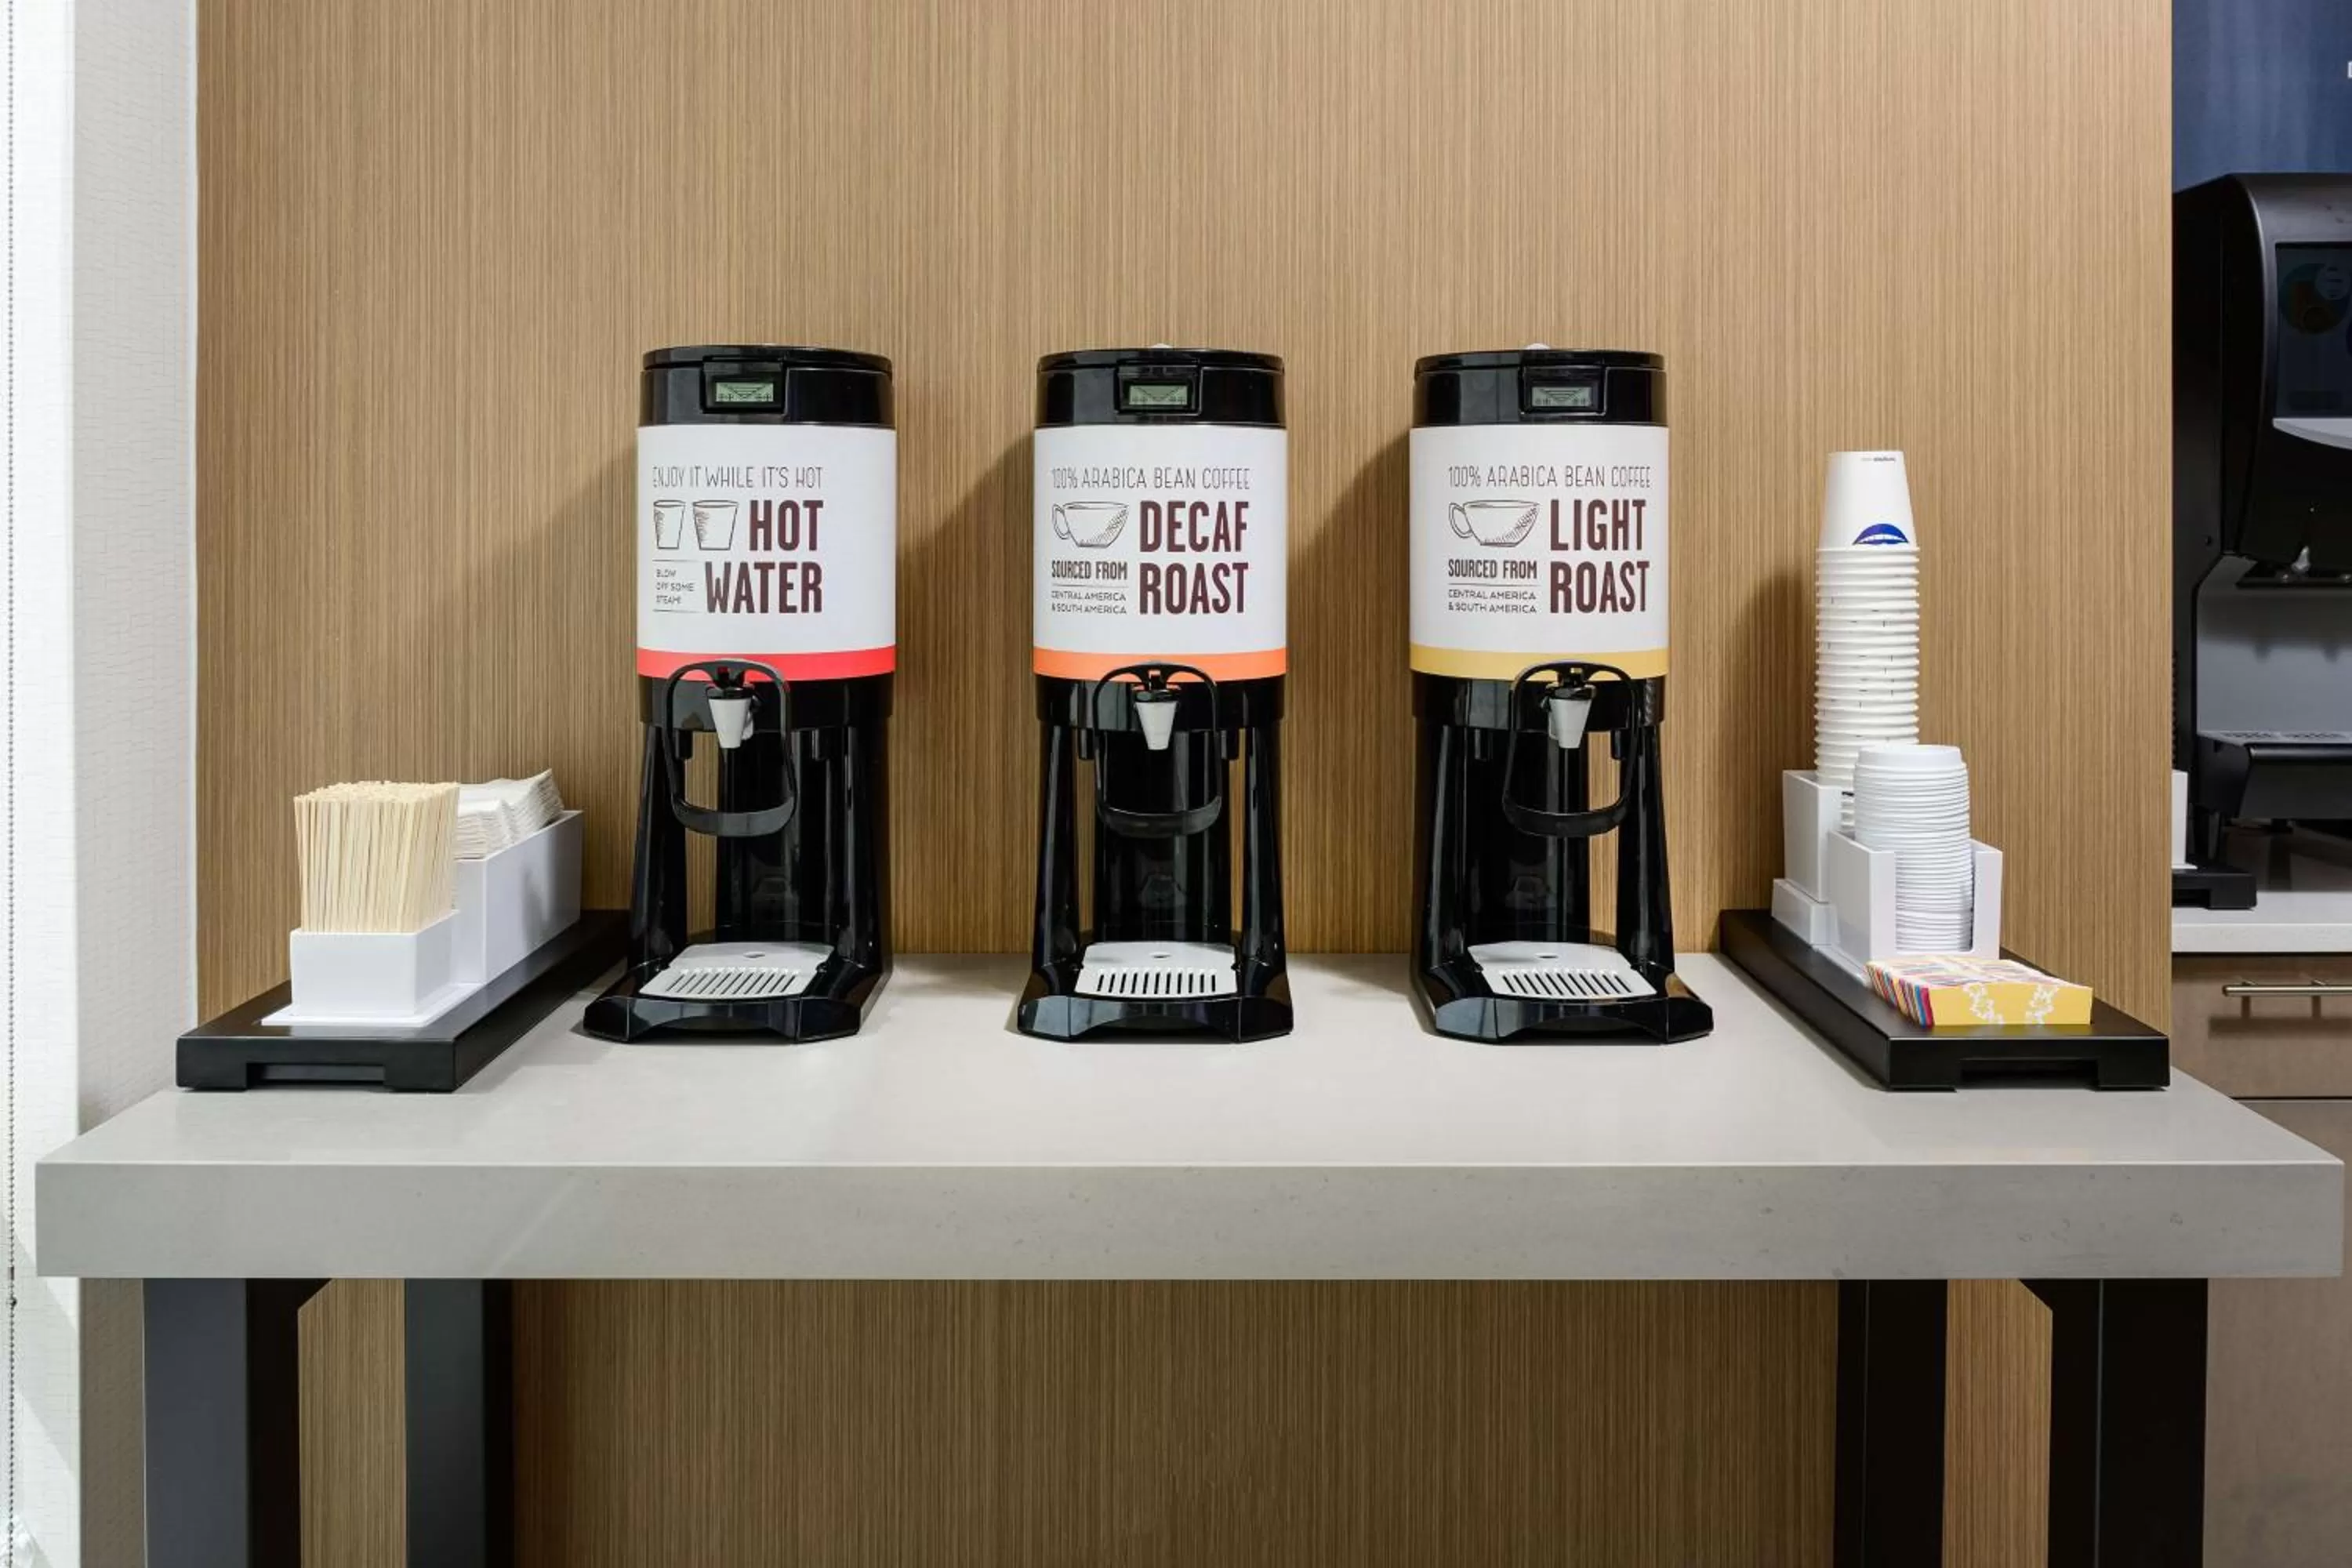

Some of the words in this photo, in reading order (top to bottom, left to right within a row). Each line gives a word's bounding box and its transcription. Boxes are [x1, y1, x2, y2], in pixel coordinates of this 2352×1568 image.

[653, 466, 684, 488] ENJOY
[689, 466, 702, 488] IT
[706, 466, 753, 488] WHILE
[762, 466, 789, 488] IT'S
[796, 466, 823, 488] HOT
[1052, 467, 1078, 489] 100%
[1081, 467, 1148, 489] ARABICA
[1154, 467, 1196, 490] BEAN
[1202, 467, 1250, 490] COFFEE
[1448, 465, 1482, 488] 100%
[1486, 465, 1558, 488] ARABICA
[1565, 465, 1605, 488] BEAN
[1611, 465, 1651, 488] COFFEE
[749, 499, 824, 551] HOT
[1139, 500, 1250, 553] DECAF
[1550, 499, 1646, 551] LIGHT
[1051, 560, 1091, 579] SOURCED
[1095, 561, 1128, 580] FROM
[1448, 559, 1497, 578] SOURCED
[1503, 560, 1537, 579] FROM
[671, 583, 695, 591] SOME
[705, 561, 823, 614] WATER
[1051, 590, 1083, 600] CENTRAL
[1084, 592, 1127, 601] AMERICA
[1139, 562, 1249, 615] ROAST
[1448, 589, 1488, 599] CENTRAL
[1490, 590, 1537, 600] AMERICA
[1550, 561, 1650, 613] ROAST
[1057, 603, 1083, 613] SOUTH
[1084, 604, 1127, 614] AMERICA
[1448, 601, 1454, 611] &
[1455, 602, 1487, 612] SOUTH
[1489, 604, 1537, 613] AMERICA
